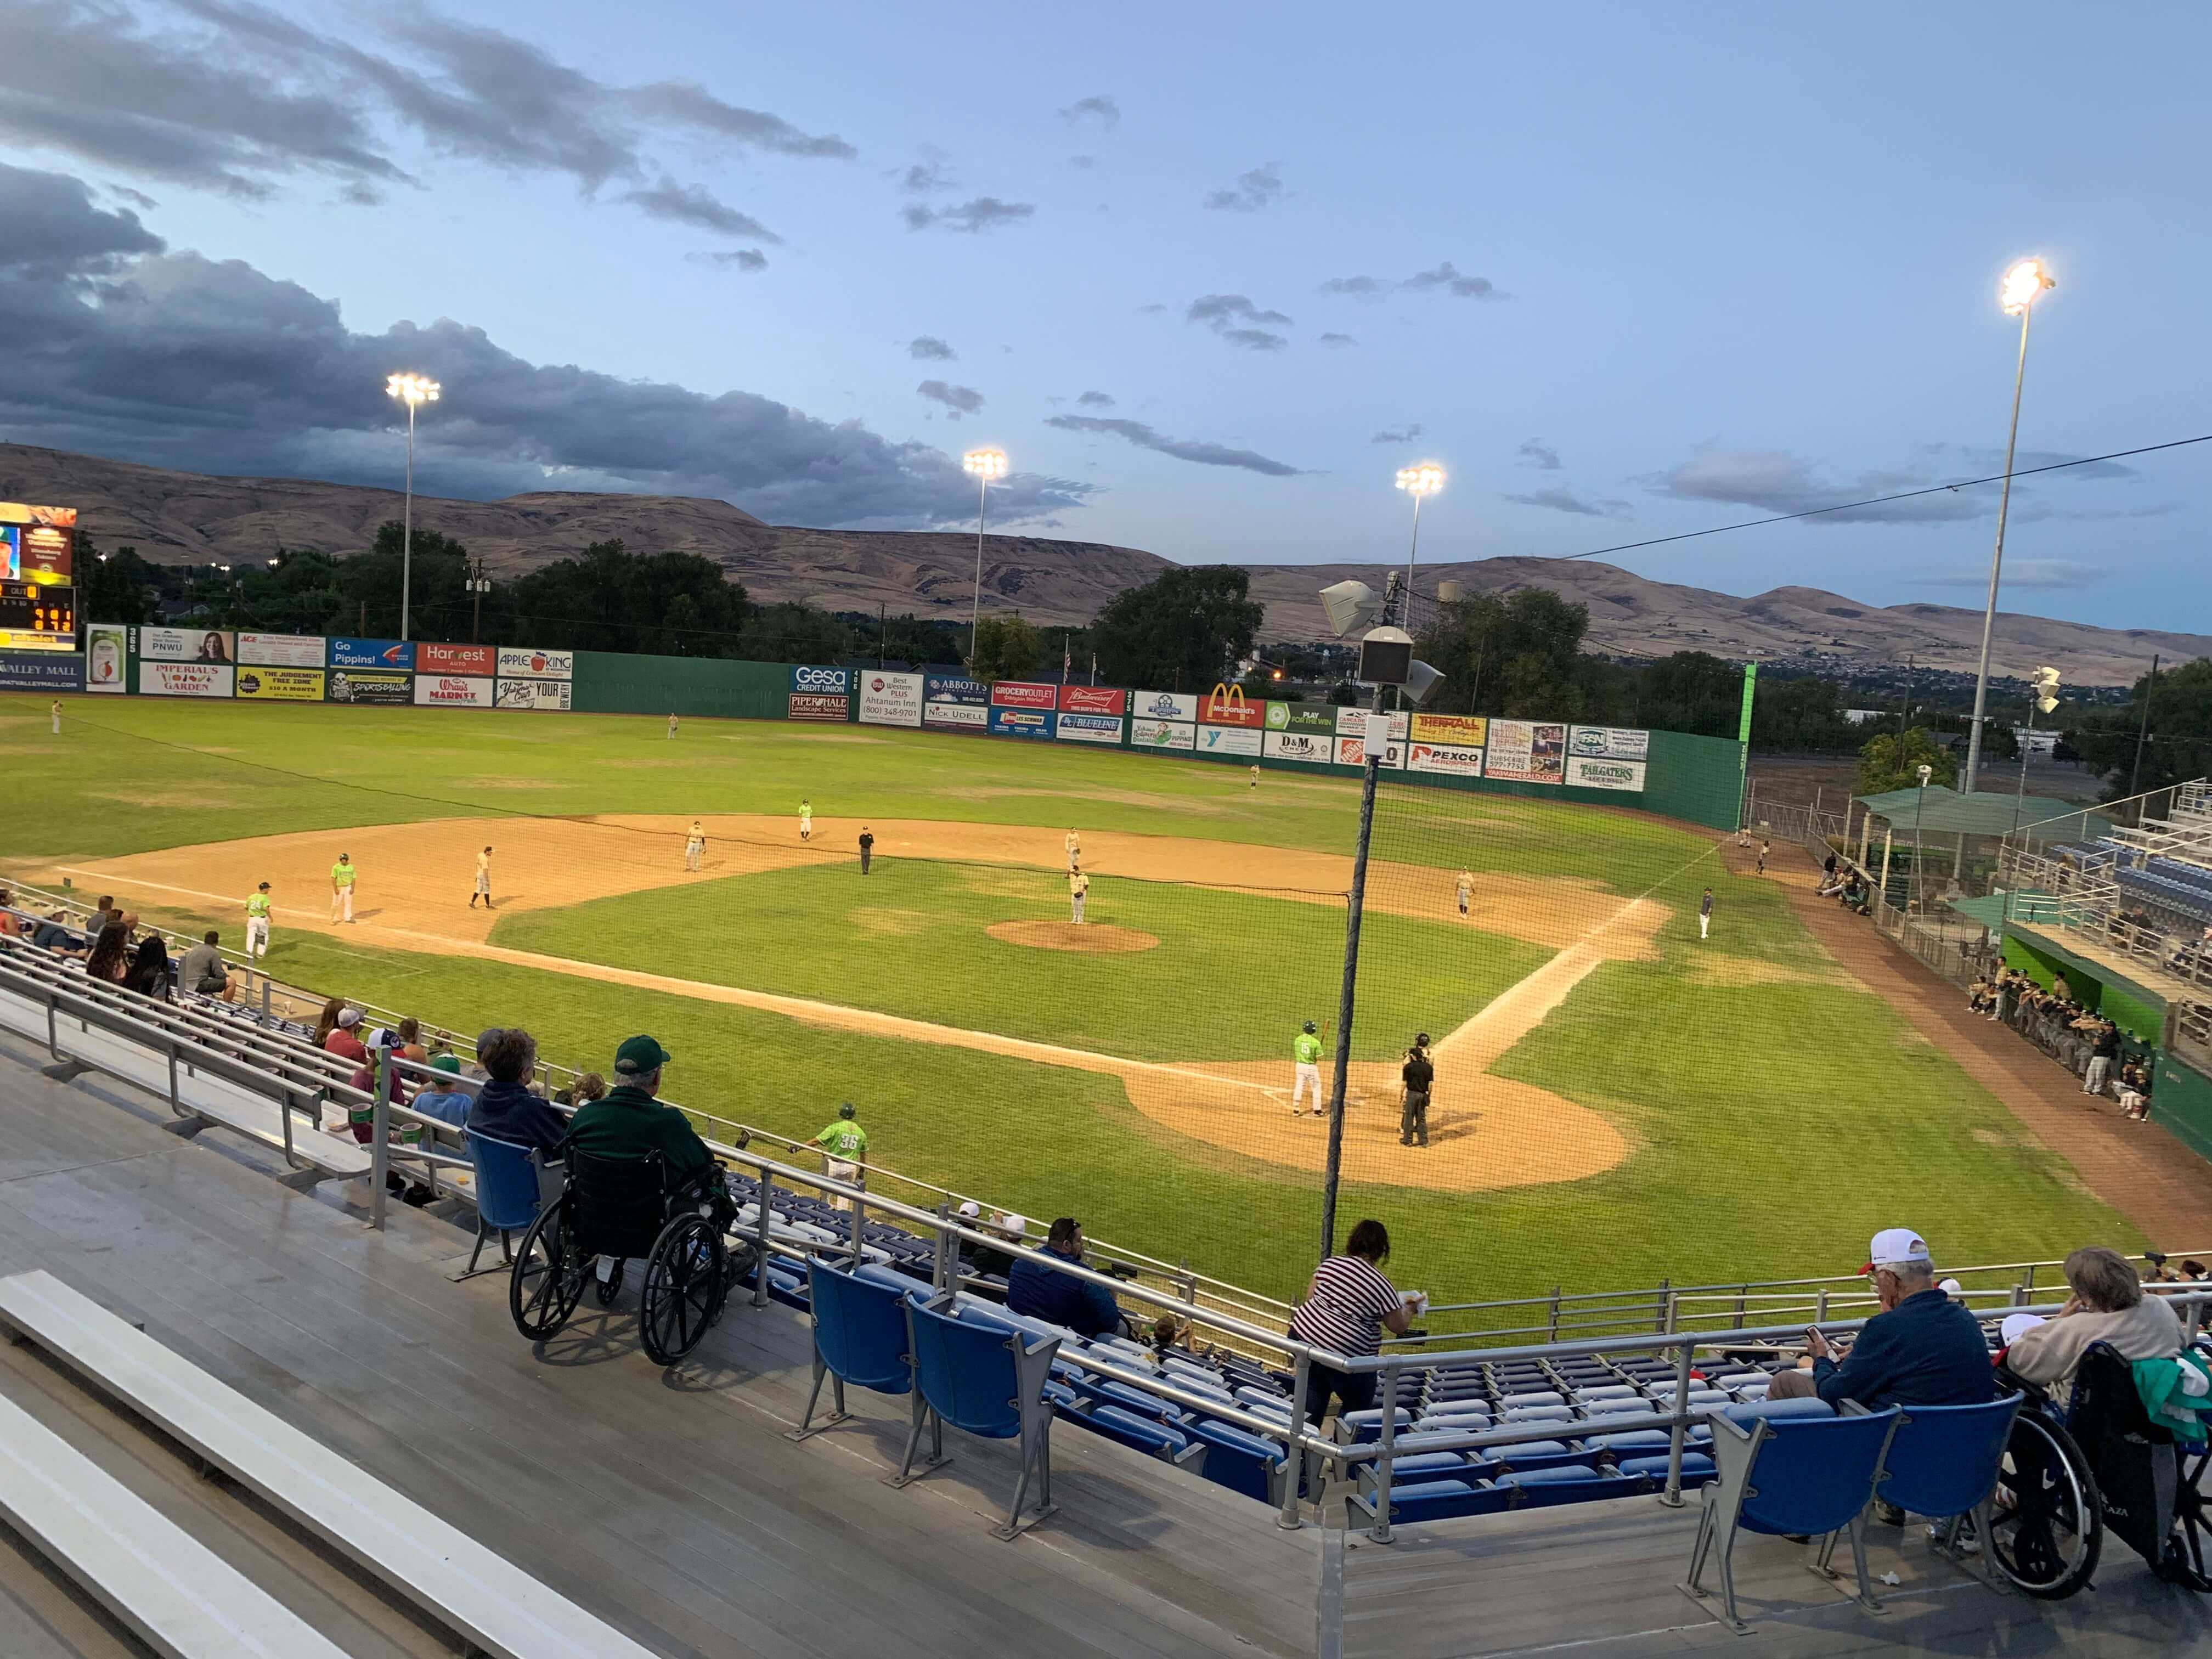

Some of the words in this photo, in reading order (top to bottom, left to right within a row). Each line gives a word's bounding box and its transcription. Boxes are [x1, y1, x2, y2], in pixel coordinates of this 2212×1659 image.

[153, 643, 182, 651] PNWU
[335, 641, 351, 650] Go
[335, 654, 375, 665] Pippins!
[427, 646, 486, 662] Harvest
[500, 654, 532, 666] APPLE
[545, 656, 571, 669] KING
[47, 667, 77, 675] MALL
[156, 664, 218, 674] IMPERIAL'S
[795, 667, 846, 685] Gesa
[165, 682, 208, 691] GARDEN
[536, 682, 558, 697] YOUR
[941, 680, 988, 691] ABBOTTS
[559, 684, 570, 709] BREWERY
[791, 696, 817, 706] PIPER
[823, 698, 847, 707] HALE
[865, 696, 901, 706] Ahtanum
[1071, 691, 1111, 702] Budweiser
[863, 706, 882, 715] (800)
[884, 708, 917, 717] 348-9701
[1213, 706, 1256, 714] McDonald's
[1076, 718, 1118, 730] BLUELINE
[1282, 736, 1310, 748] D&M
[1340, 742, 1363, 762] HOME
[1432, 751, 1479, 762] PEXCO
[1430, 759, 1477, 767] AEROSPACE
[1489, 755, 1526, 764] SUBSCRIBE
[1489, 761, 1525, 770] 577-7755
[1487, 769, 1560, 782] YAKIMAHERALD.COM
[1580, 764, 1633, 781] TAILGATERS
[1301, 1042, 1311, 1054] 15
[839, 1133, 859, 1150] 36
